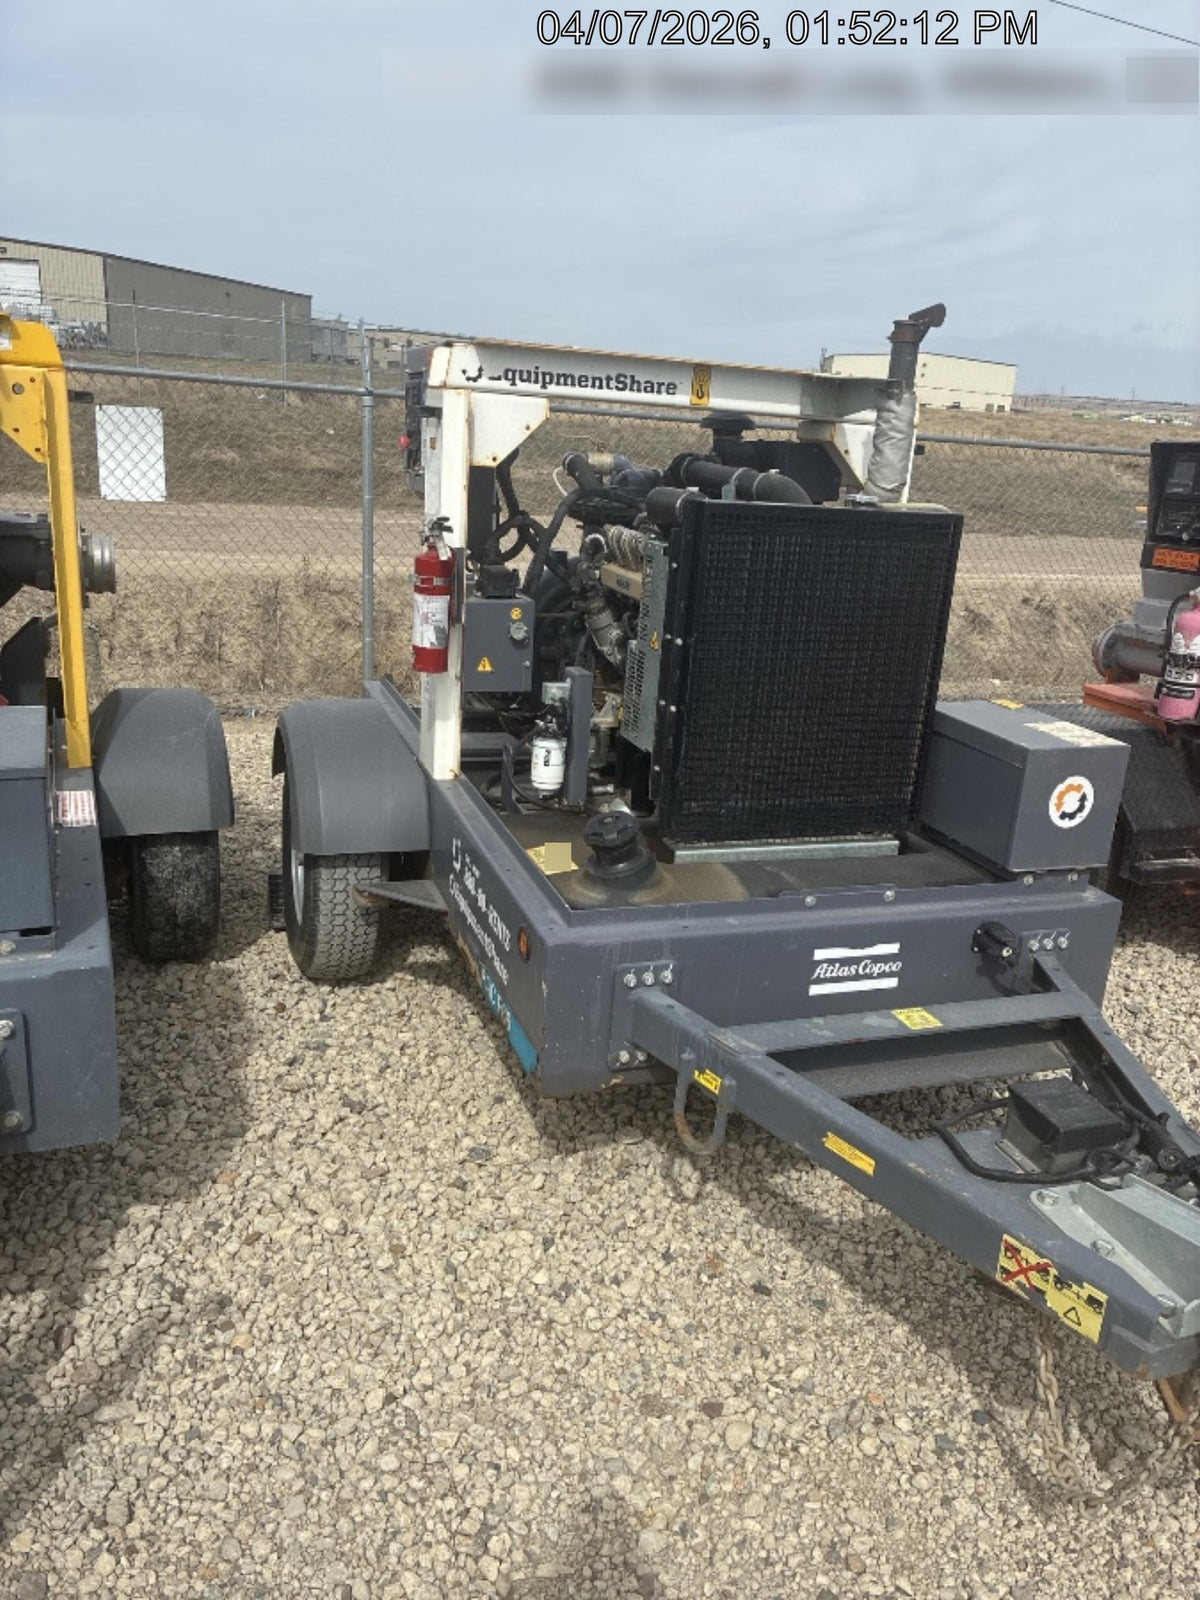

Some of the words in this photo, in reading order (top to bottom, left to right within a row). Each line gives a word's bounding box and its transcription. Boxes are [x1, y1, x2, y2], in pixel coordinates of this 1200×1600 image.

[488, 366, 678, 396] quipmentShare
[811, 963, 857, 980] Atlas
[858, 959, 902, 977] Copco
